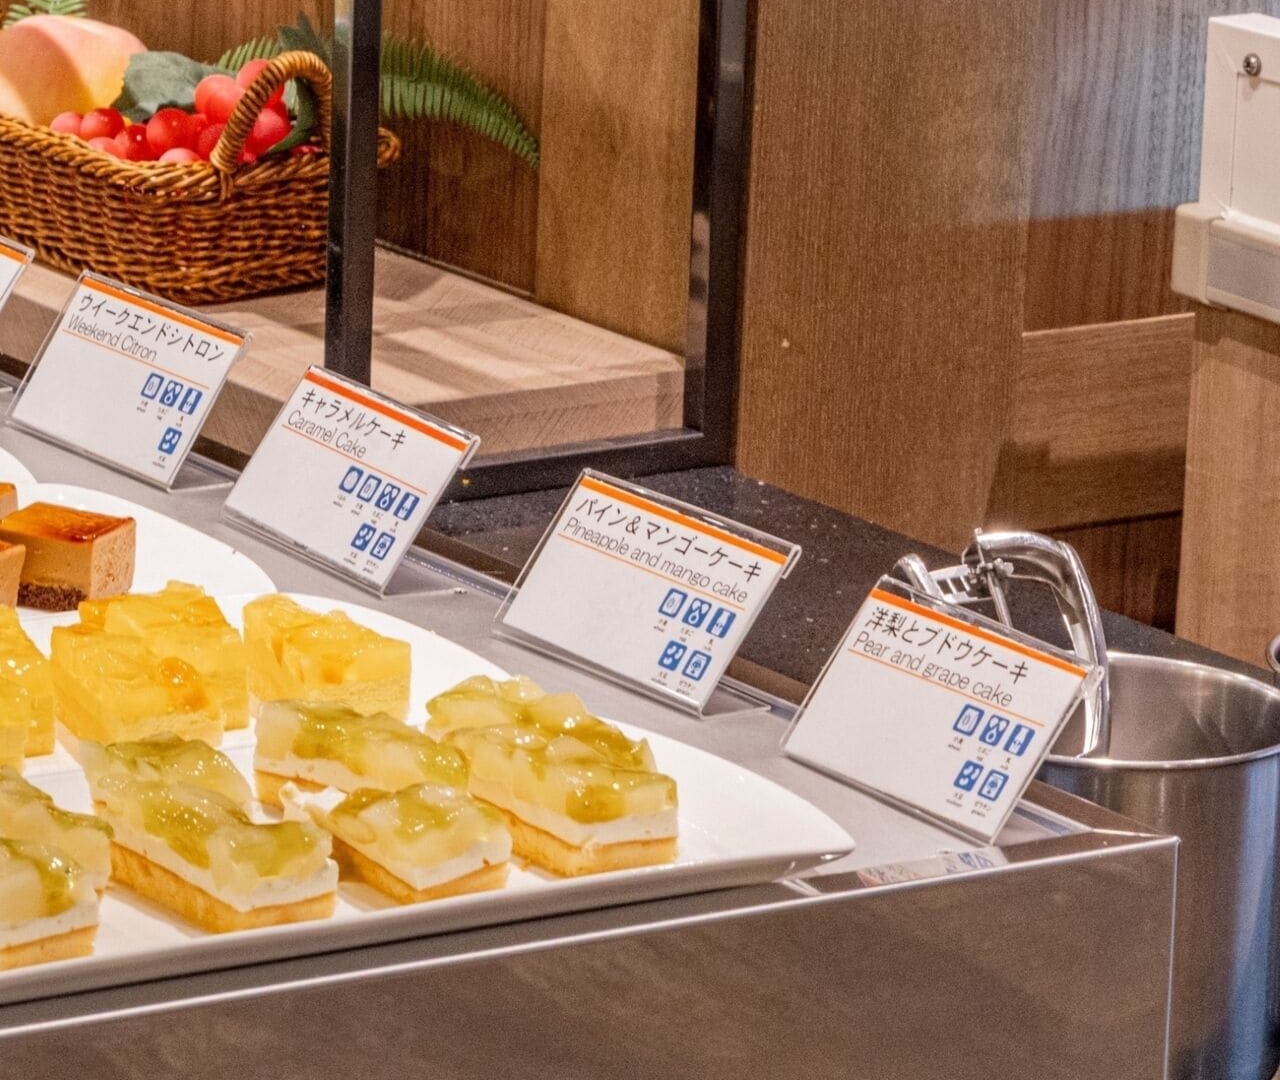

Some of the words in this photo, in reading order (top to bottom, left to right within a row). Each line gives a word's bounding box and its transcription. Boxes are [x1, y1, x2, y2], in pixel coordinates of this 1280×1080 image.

[68, 313, 121, 347] Weekend
[121, 334, 158, 362] Citron
[79, 293, 224, 361] ウイークエンドシトロン
[287, 409, 338, 443] Caramel
[335, 431, 367, 458] Cake
[302, 388, 406, 450] キャラメルケーキ
[563, 516, 630, 555] Pineapple
[630, 546, 663, 568] and
[660, 558, 711, 587] mango
[712, 578, 748, 604] cake
[853, 630, 890, 658] Pear
[890, 648, 925, 671] and
[921, 661, 970, 693] grape
[972, 680, 1013, 707] cake
[865, 606, 1029, 685] 洋梨とブドウケーキ
